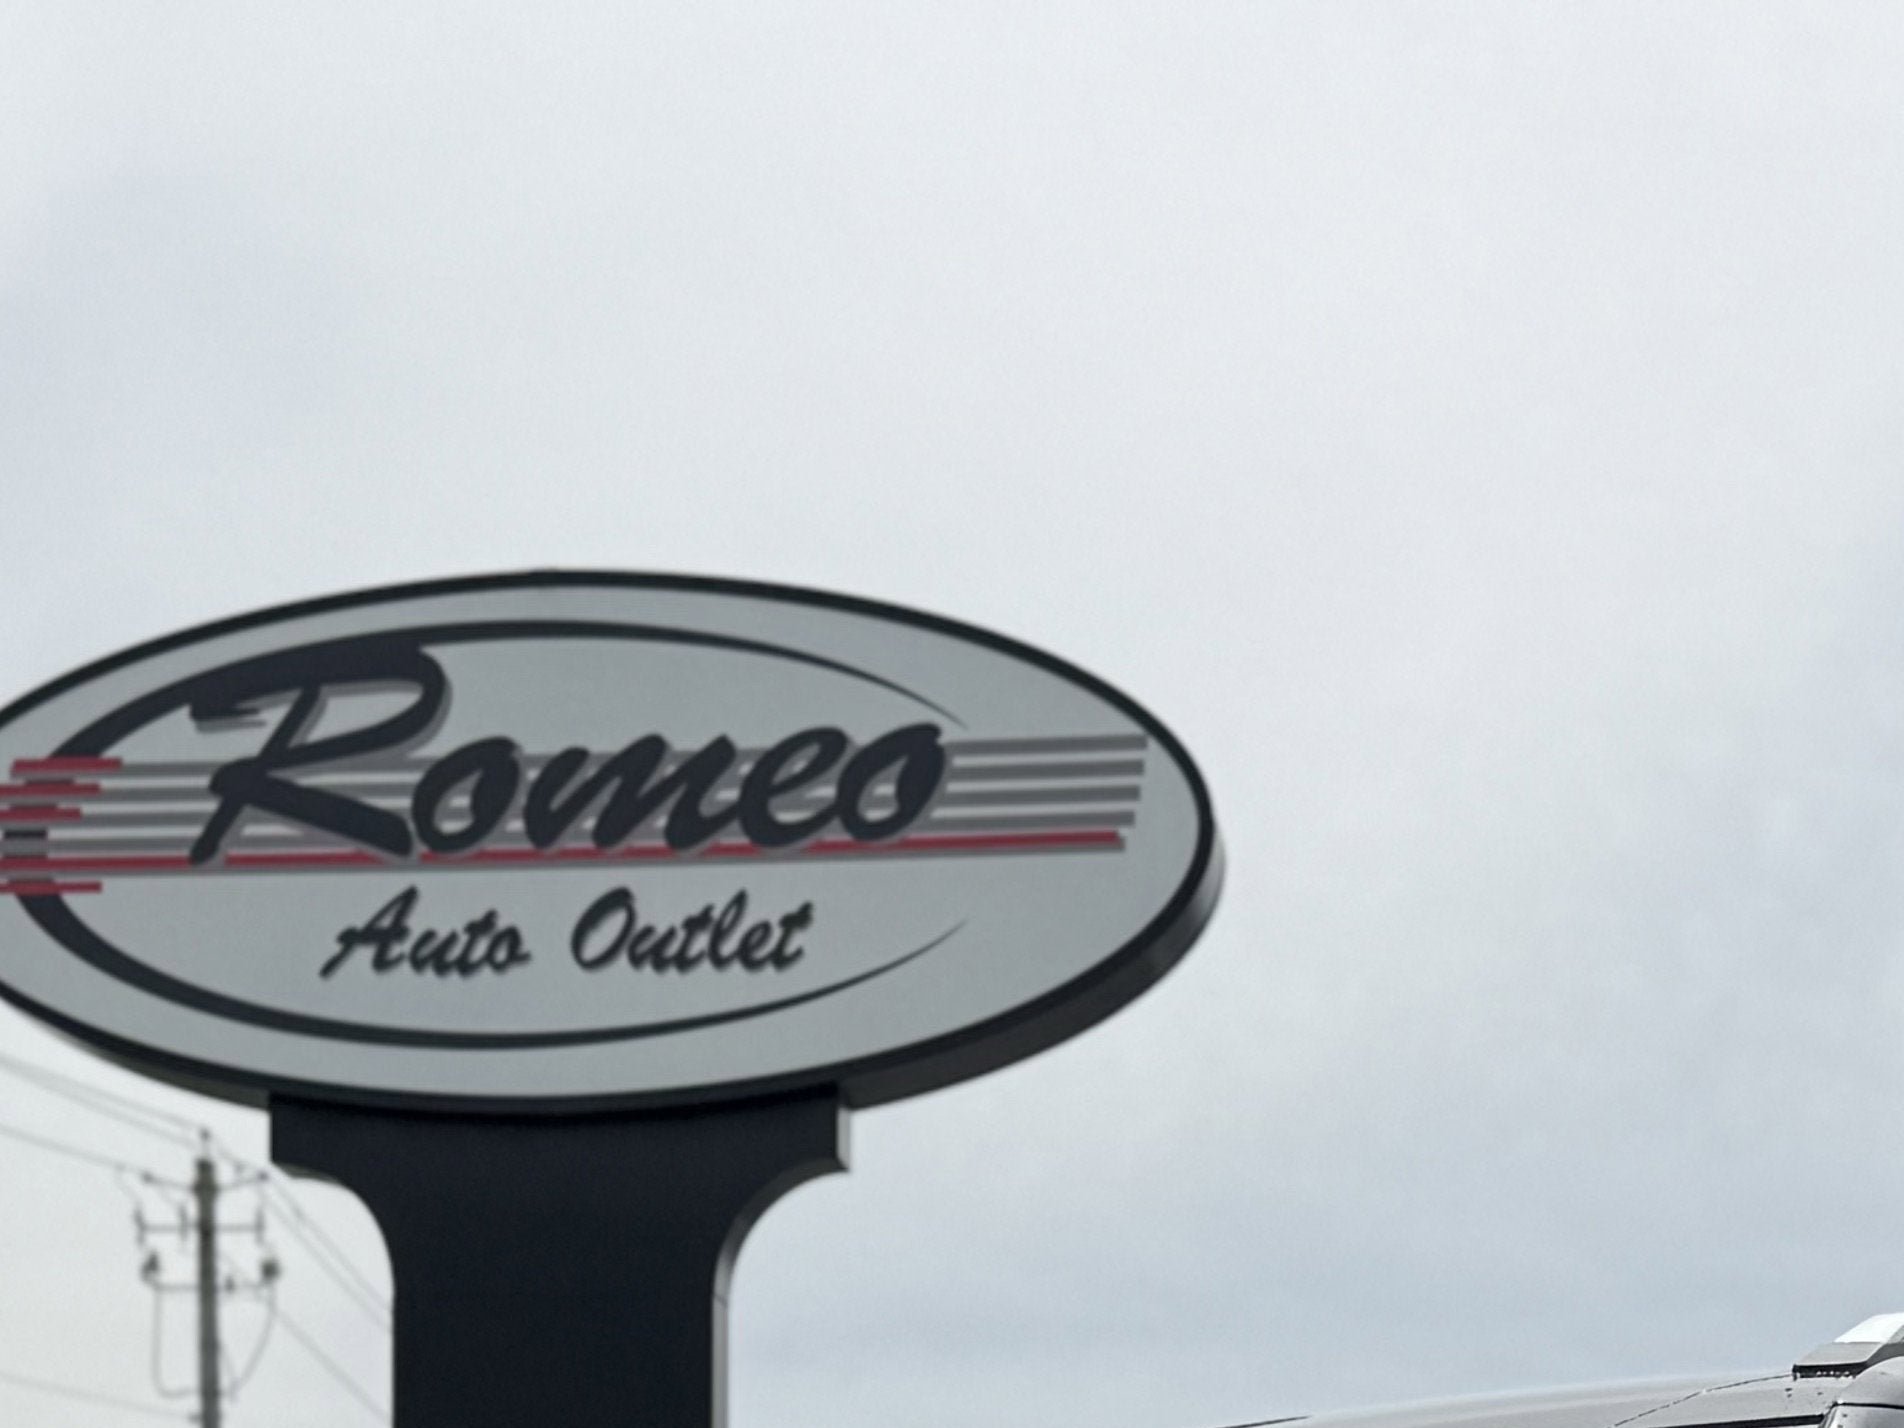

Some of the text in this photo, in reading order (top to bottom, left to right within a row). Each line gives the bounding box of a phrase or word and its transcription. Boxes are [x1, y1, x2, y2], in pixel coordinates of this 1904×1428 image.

[189, 643, 946, 866] Romeo
[319, 887, 814, 978] Auto Outlet
